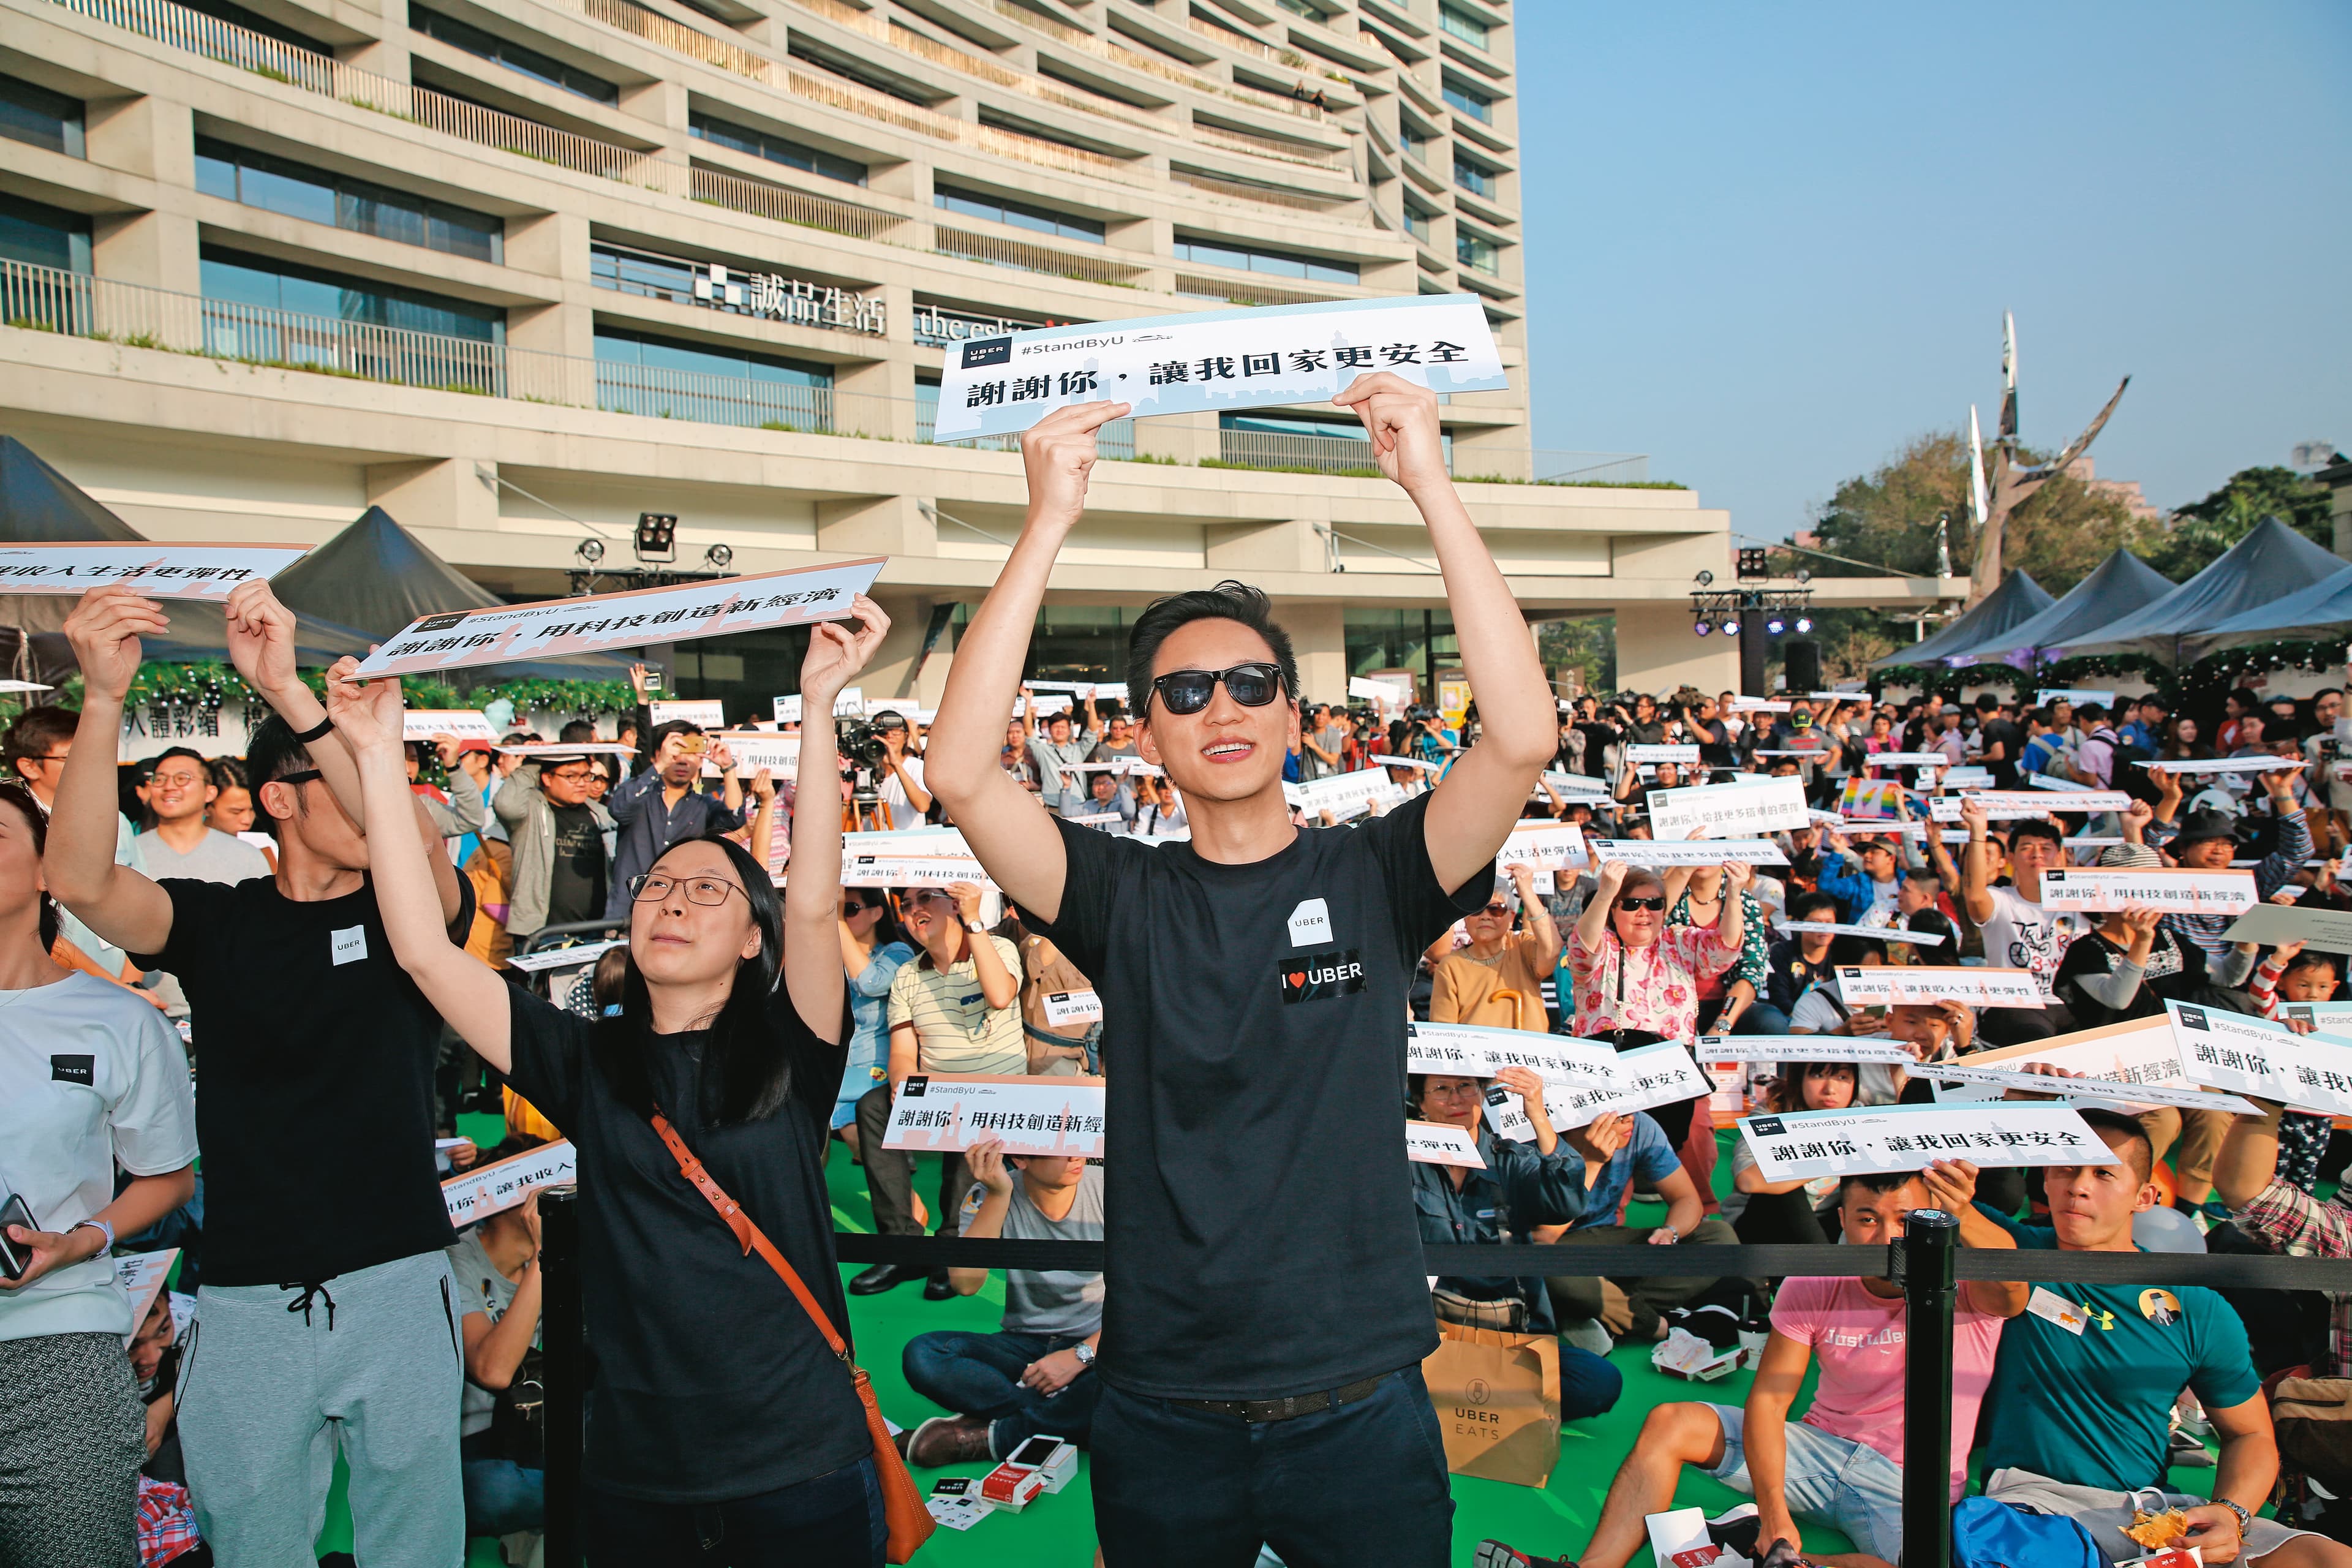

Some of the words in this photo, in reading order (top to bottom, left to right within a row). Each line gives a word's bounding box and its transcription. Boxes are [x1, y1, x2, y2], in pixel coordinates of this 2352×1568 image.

[749, 273, 886, 334] 誠品生活
[919, 305, 964, 341] the
[970, 346, 1004, 356] UBER
[1021, 336, 1124, 355] #StandByU
[467, 608, 559, 624] #StandByU
[1295, 917, 1324, 927] UBER
[337, 939, 361, 951] UBER
[1282, 974, 1287, 989] I
[1308, 962, 1363, 986] UBER
[2182, 1012, 2203, 1020] UBER
[2214, 1022, 2272, 1041] #StandByU
[2193, 1042, 2352, 1098] 謝謝你，讓我
[929, 1086, 976, 1095] #StandByU
[898, 1110, 1105, 1133] 謝謝你，用科技創造新經
[1790, 1118, 1856, 1131] #StandByU
[1825, 1329, 1865, 1348] Just
[1455, 1408, 1500, 1424] UBER
[1456, 1424, 1499, 1440] EATS
